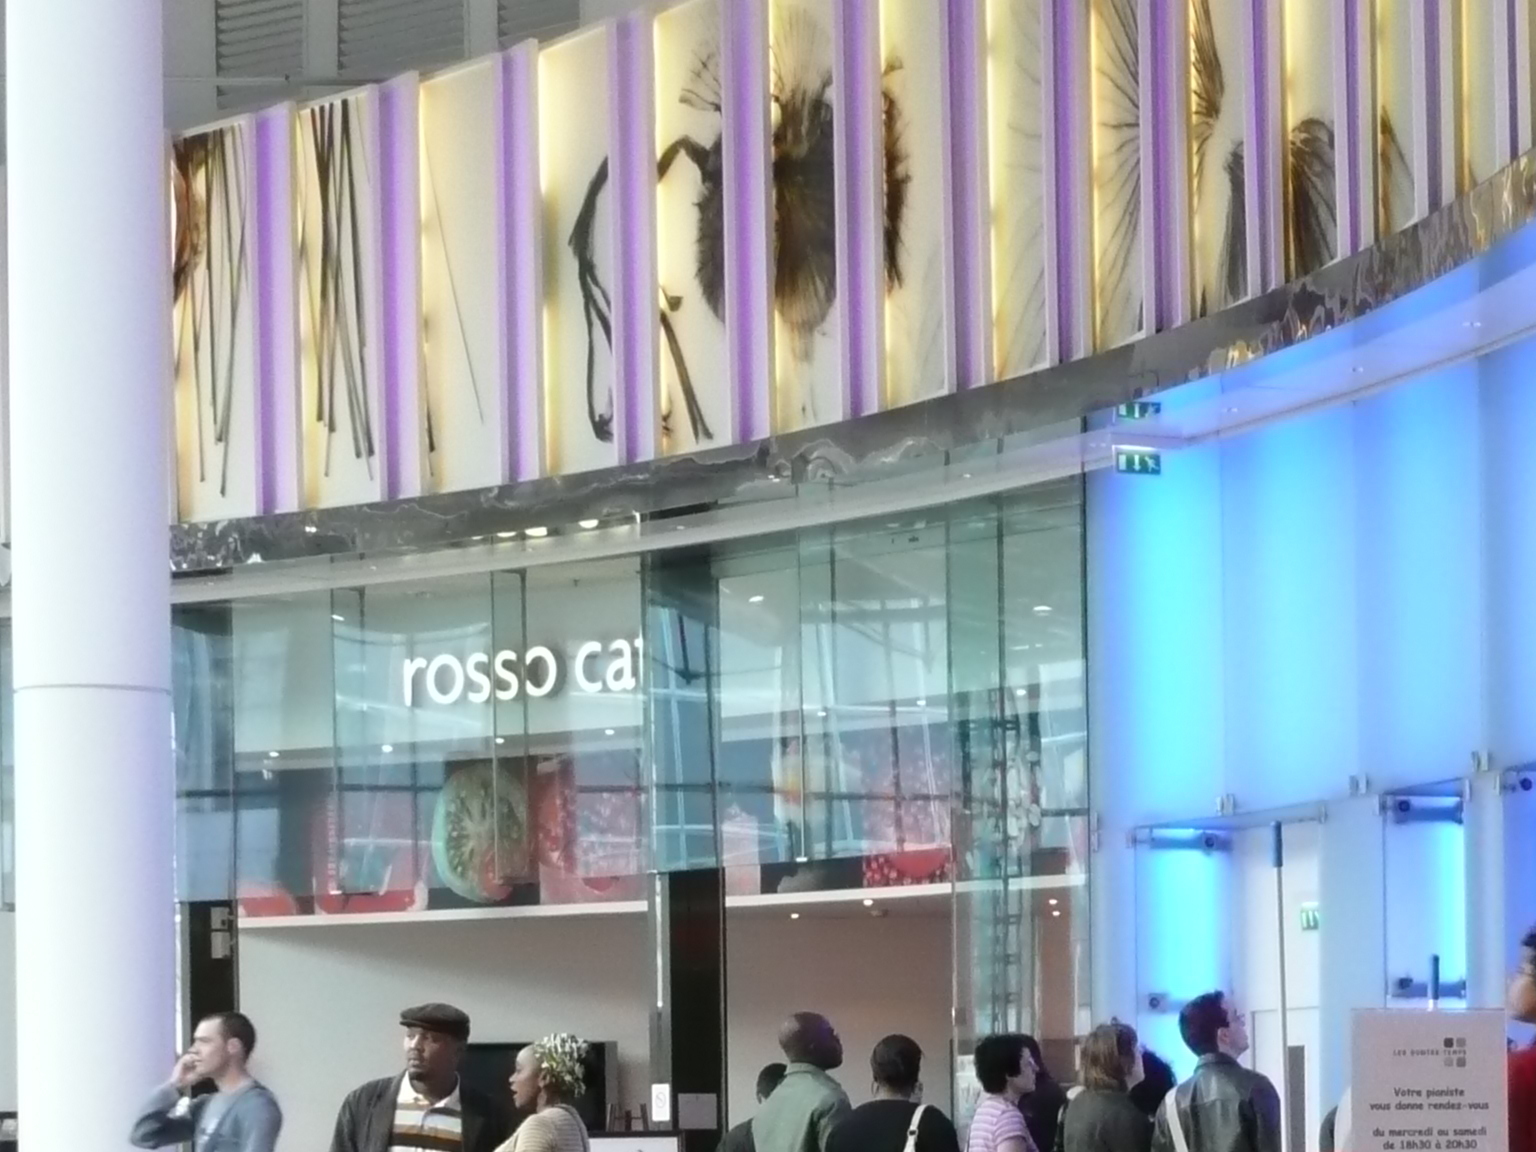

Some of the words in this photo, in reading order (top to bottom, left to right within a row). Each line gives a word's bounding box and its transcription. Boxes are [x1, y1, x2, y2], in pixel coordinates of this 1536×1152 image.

[402, 646, 557, 707] rosso
[1443, 1048, 1467, 1056] TEMPS
[1393, 1087, 1422, 1097] Votre
[1426, 1086, 1465, 1099] pianiste
[1369, 1102, 1391, 1111] vous
[1394, 1100, 1423, 1111] donne
[1428, 1100, 1489, 1110] rendez-vous
[1372, 1127, 1385, 1137] du
[1388, 1126, 1433, 1137] mercredi
[1437, 1128, 1449, 1137] au
[1453, 1126, 1487, 1136] samedi
[1382, 1140, 1395, 1150] de
[1400, 1140, 1431, 1150] 18h30
[1435, 1140, 1442, 1149] à
[1445, 1139, 1478, 1149] 20h30
